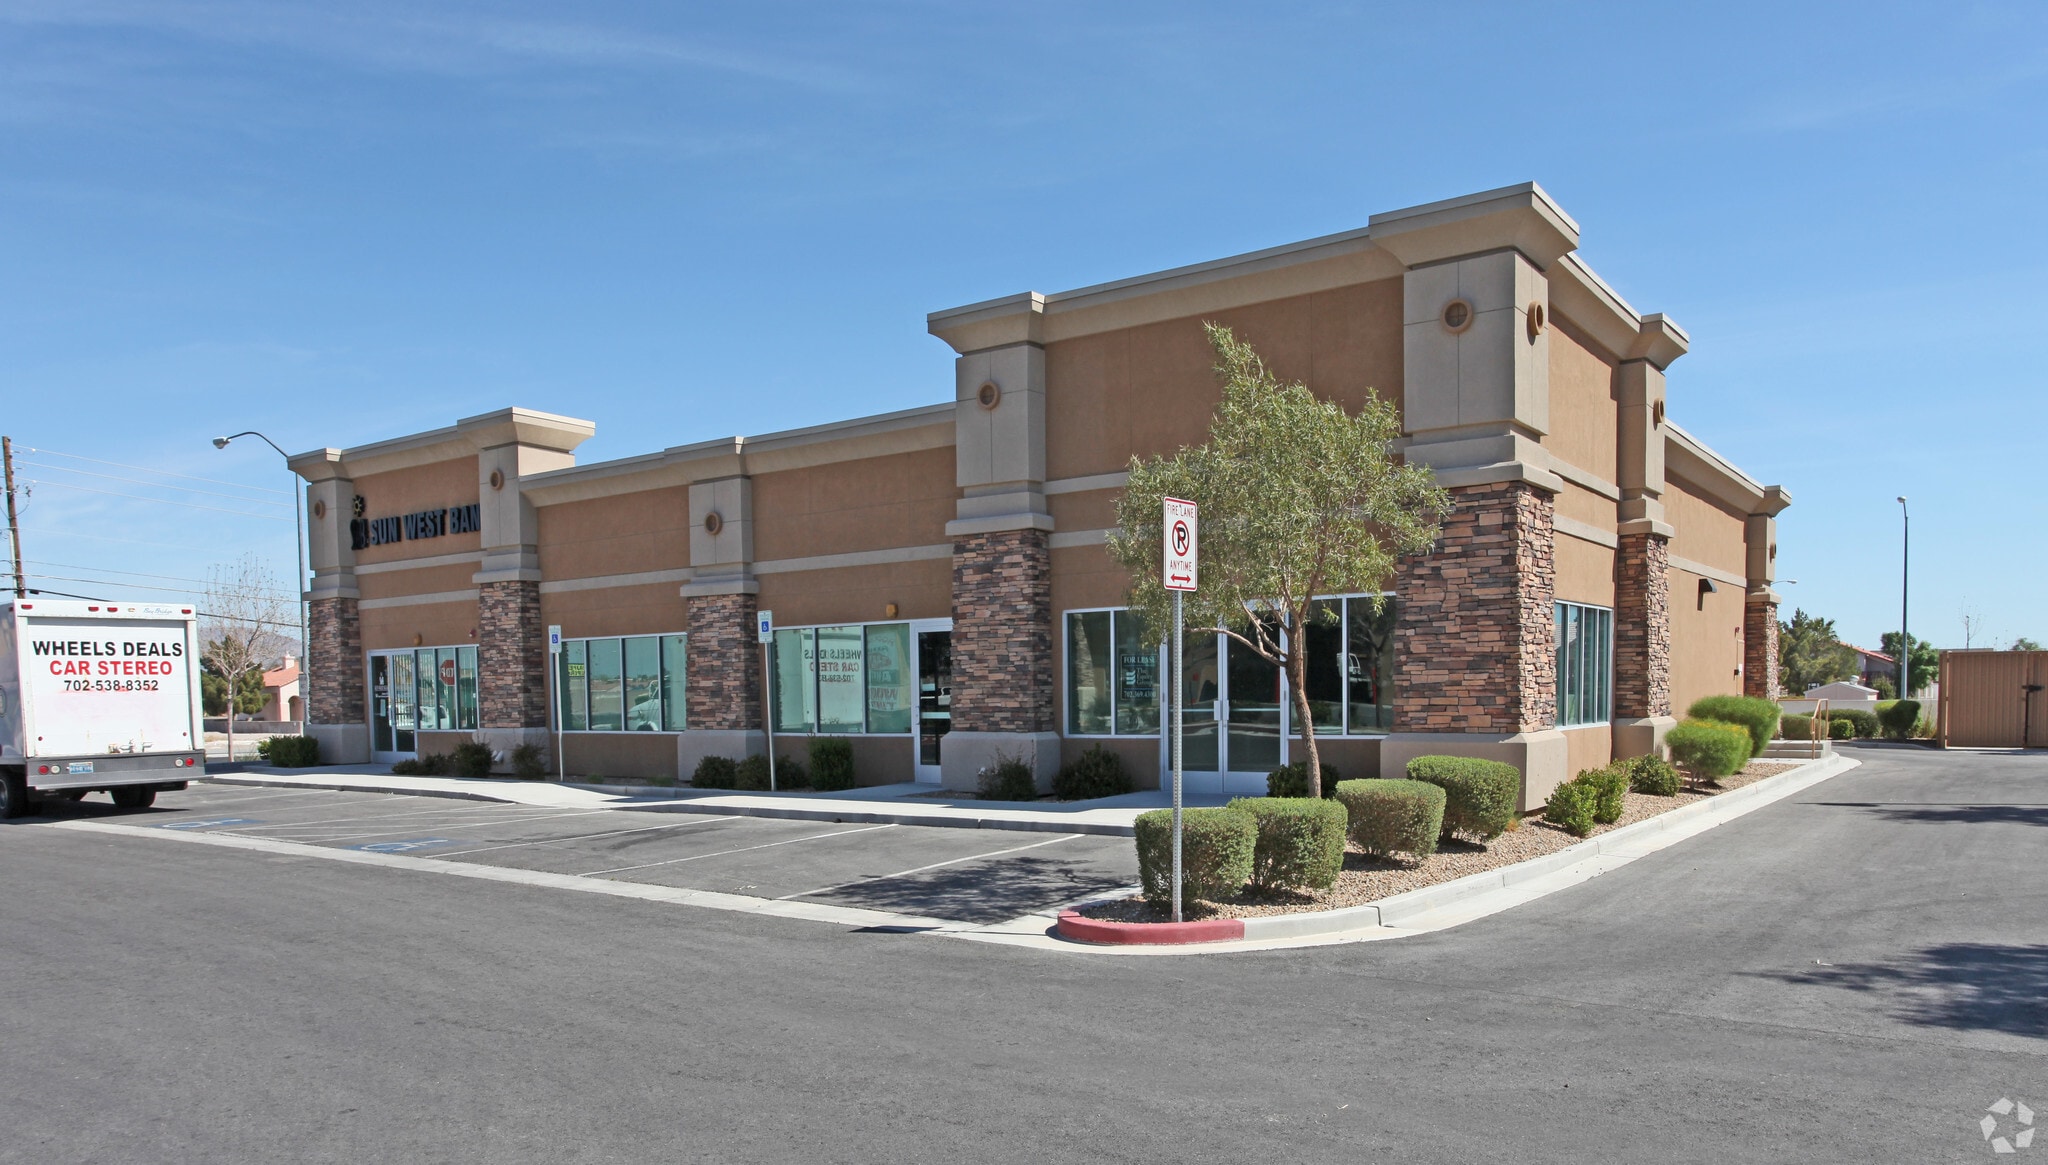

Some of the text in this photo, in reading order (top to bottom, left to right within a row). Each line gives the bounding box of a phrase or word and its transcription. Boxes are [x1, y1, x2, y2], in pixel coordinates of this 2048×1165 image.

[1167, 503, 1194, 519] FIRE LANE
[370, 516, 402, 546] SUN
[403, 508, 447, 541] WEST
[450, 503, 481, 534] BAN
[1170, 559, 1192, 572] ANYTIME
[32, 641, 183, 657] WHEELS DEALS
[49, 660, 172, 676] CAR STEREO
[1123, 656, 1156, 664] FOR LEASE
[64, 679, 159, 692] 702-538-8352
